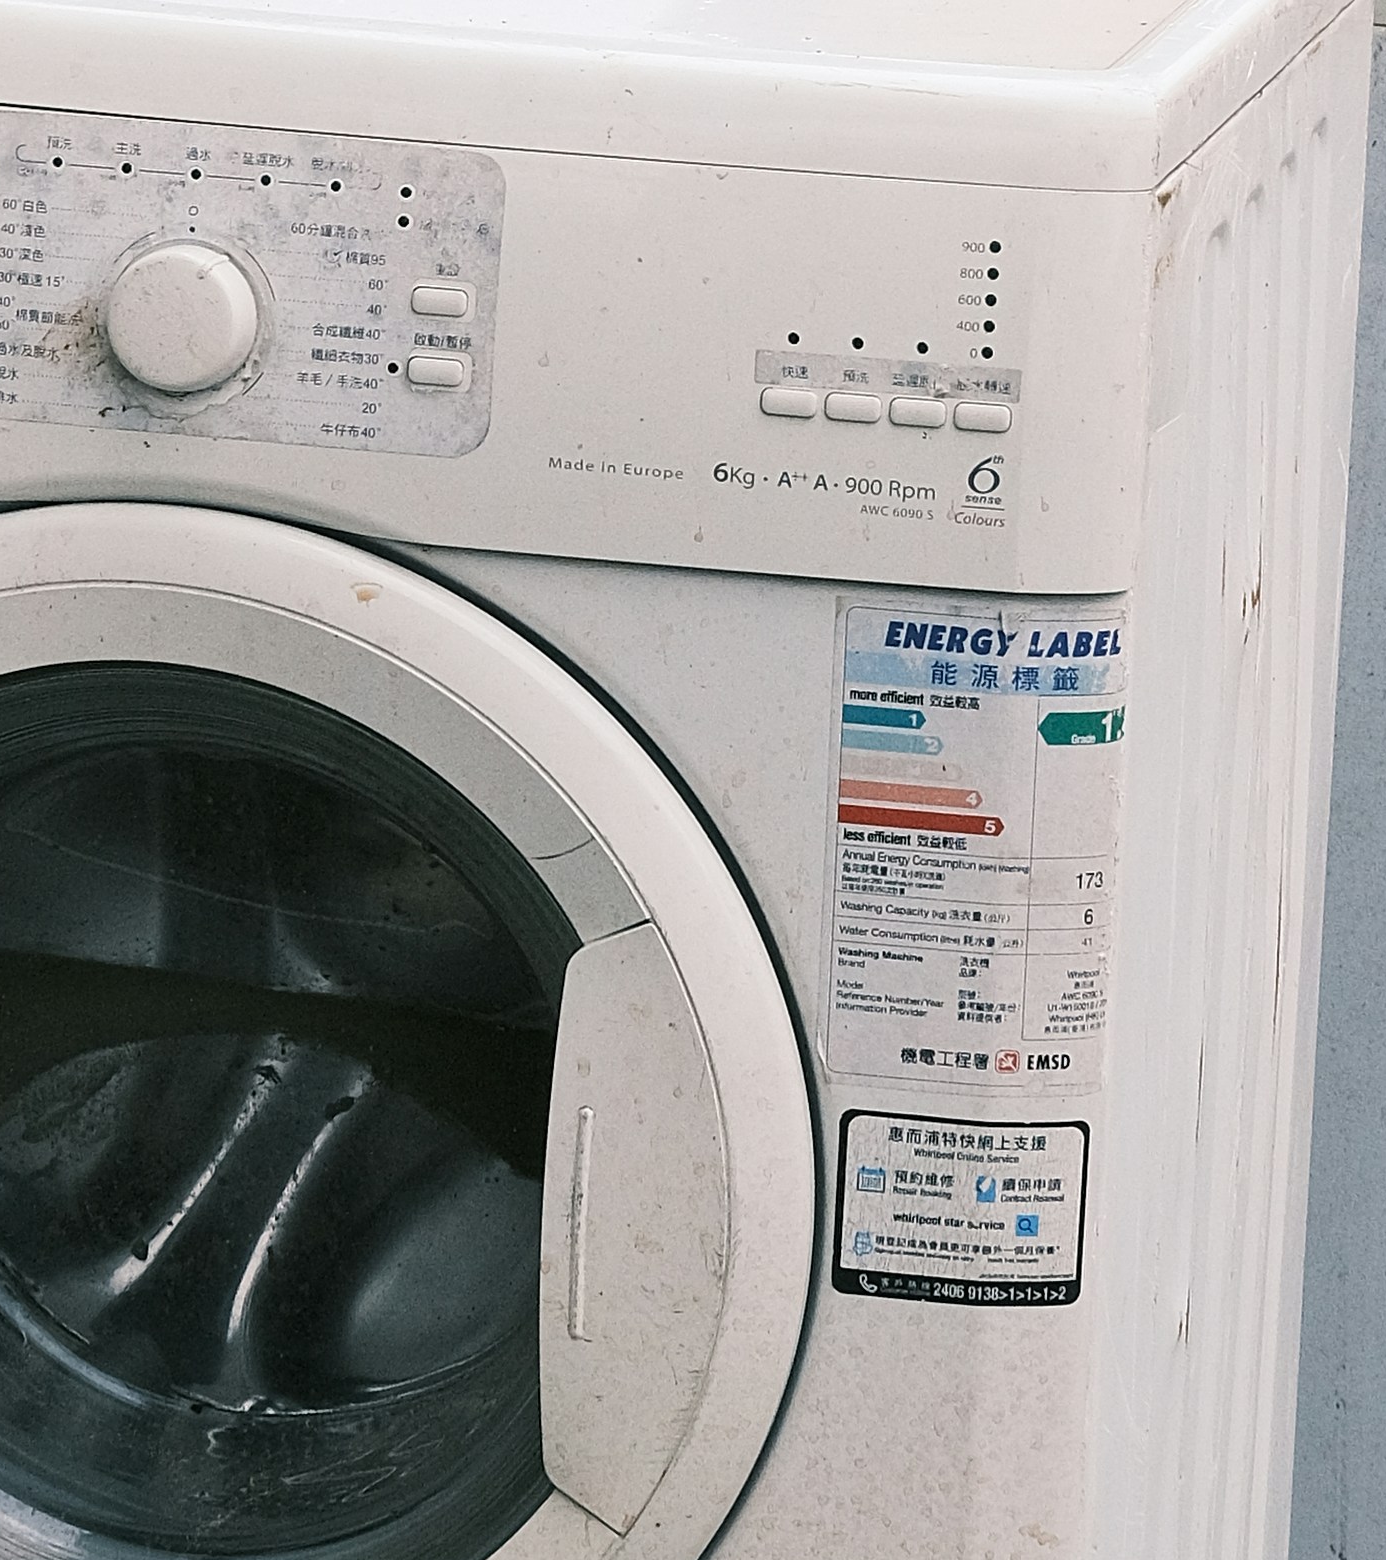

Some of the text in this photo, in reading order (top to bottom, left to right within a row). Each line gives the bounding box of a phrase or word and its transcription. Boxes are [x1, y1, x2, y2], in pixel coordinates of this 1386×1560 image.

[115, 142, 141, 156] 主洗
[961, 241, 985, 253] 900
[960, 267, 983, 280] 800
[958, 293, 982, 306] 600
[956, 320, 980, 333] 400
[969, 347, 978, 360] 0
[782, 366, 809, 380] 快速
[548, 456, 595, 472] Made
[623, 463, 684, 480] Europe
[713, 462, 756, 489] 6Kg
[813, 474, 829, 491] A
[845, 476, 883, 496] 900
[888, 480, 936, 502] Rpm
[964, 494, 1003, 506] sense
[860, 505, 889, 517] AWC
[954, 511, 1006, 528] Colours
[884, 621, 1122, 658] ENERGY LABEL
[930, 661, 1080, 692] 能源標籤
[849, 689, 878, 701] more
[880, 690, 924, 706] efficient
[908, 713, 917, 726] 1
[925, 738, 939, 752] 2
[966, 792, 979, 805] 4
[984, 820, 997, 833] 5
[843, 829, 865, 843] less
[867, 830, 911, 846] efficient
[842, 849, 876, 862] Annual
[878, 852, 911, 866] Energy
[912, 855, 976, 871] Consumption
[1076, 871, 1104, 890] 173
[840, 900, 883, 914] Washing
[885, 904, 929, 918] Capacity
[1084, 909, 1094, 925] 6
[839, 924, 869, 937] Water
[871, 928, 938, 943] Consumption
[838, 947, 923, 963] Washing Machine
[838, 957, 865, 968] Brand
[837, 979, 864, 990] Model
[836, 991, 945, 1008] Reference Number/Year
[836, 1002, 928, 1017] Information Provider
[900, 1047, 989, 1071] 機電工程署
[1026, 1054, 1071, 1071] EMSD
[888, 1127, 1047, 1151] 惠而浦特快網上支援
[913, 1148, 1019, 1164] Whirlpool Online Service
[894, 1170, 955, 1188] 預約維修
[893, 1186, 952, 1200] Repair Booking
[1000, 1194, 1032, 1203] Contract
[893, 1212, 941, 1226] whirlpool
[944, 1216, 964, 1226] star
[933, 1282, 965, 1299] 2406
